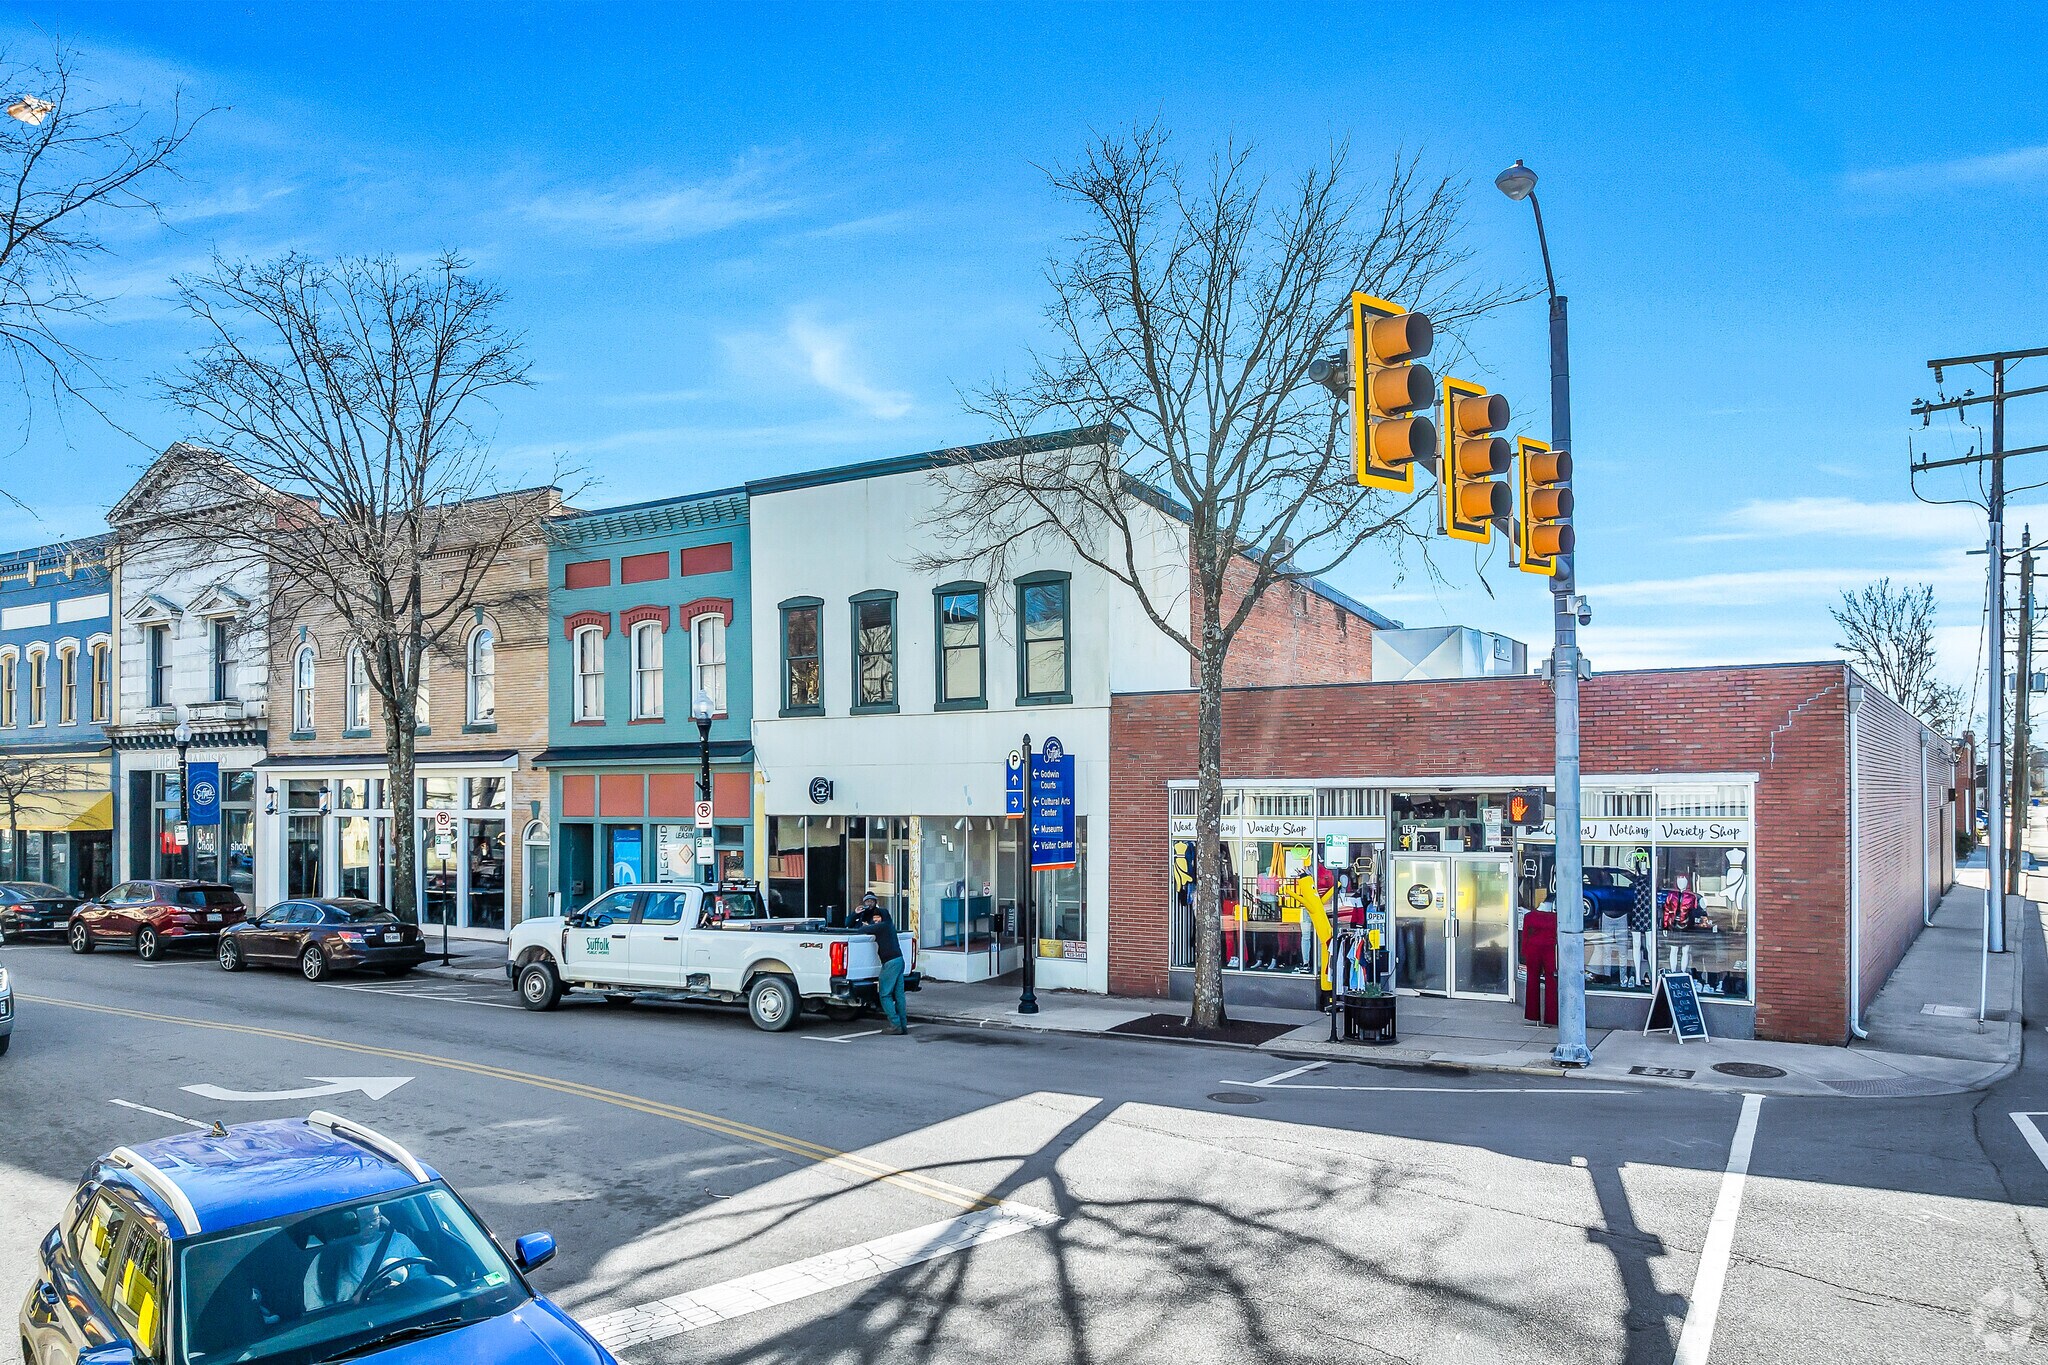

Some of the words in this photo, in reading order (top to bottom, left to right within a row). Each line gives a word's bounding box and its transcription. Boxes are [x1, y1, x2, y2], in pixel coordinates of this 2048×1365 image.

[1012, 755, 1018, 766] P
[1041, 770, 1060, 778] Godwin
[1041, 781, 1056, 789] Courts
[1041, 798, 1060, 806] Cultural
[1061, 797, 1071, 806] Arts
[1041, 809, 1057, 817] Center
[1041, 825, 1064, 833] Museums
[1173, 821, 1194, 832] Next
[1247, 821, 1281, 836] Variety
[1282, 822, 1307, 836] Shop
[1403, 825, 1417, 833] 157
[1609, 823, 1651, 838] Nothing
[1661, 822, 1707, 840] Variety
[1709, 823, 1742, 840] Shop
[230, 841, 248, 853] shop
[1041, 841, 1057, 849] Visitor
[1057, 840, 1073, 848] Center
[586, 937, 610, 951] Suffolk
